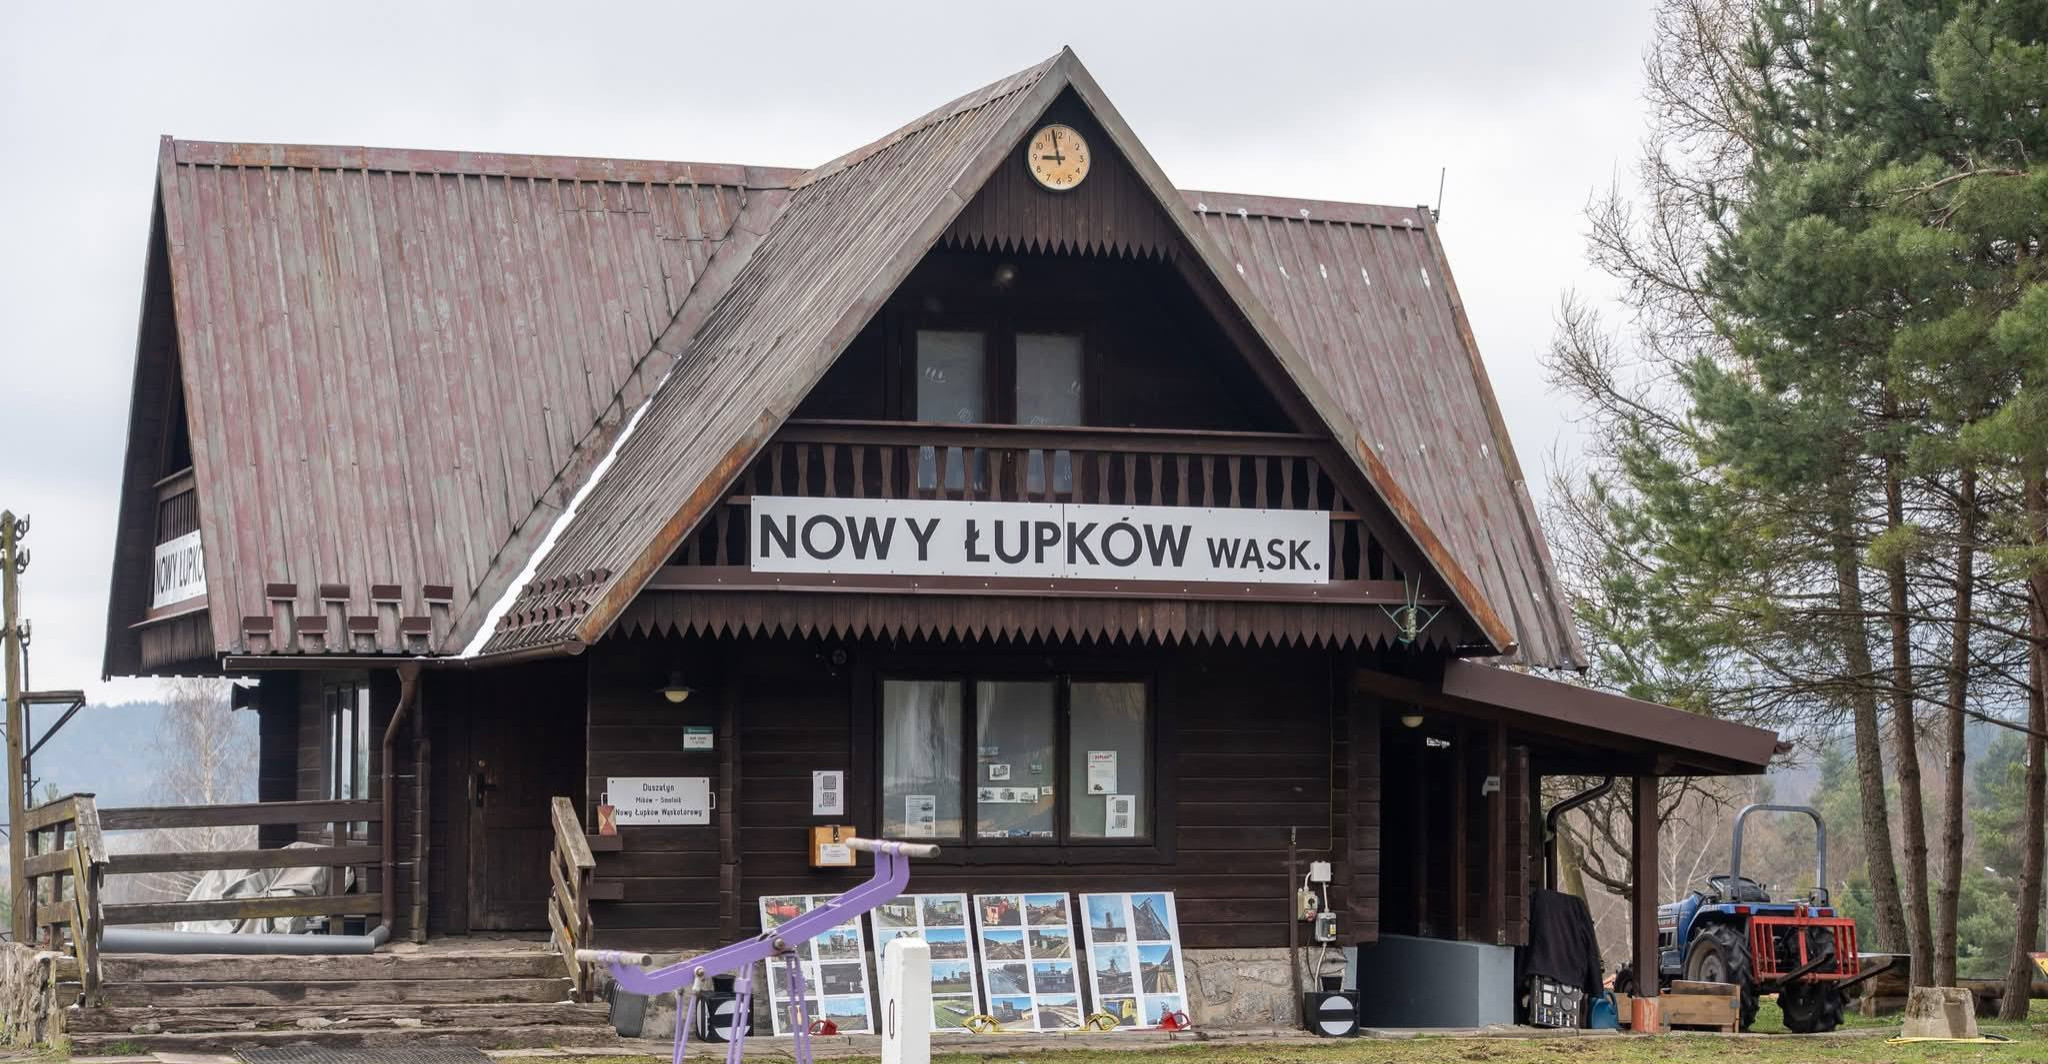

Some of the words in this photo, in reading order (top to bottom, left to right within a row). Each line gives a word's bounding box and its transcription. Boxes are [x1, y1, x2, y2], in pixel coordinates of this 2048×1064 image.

[759, 513, 941, 561] NOWY
[964, 516, 1193, 567] ŁUPKÓW
[1206, 537, 1321, 573] WĄSK.
[155, 551, 178, 596] NOWY
[642, 783, 675, 794] Duszatyn
[615, 809, 632, 817] Nowy
[661, 808, 703, 817] Wąskotorowy
